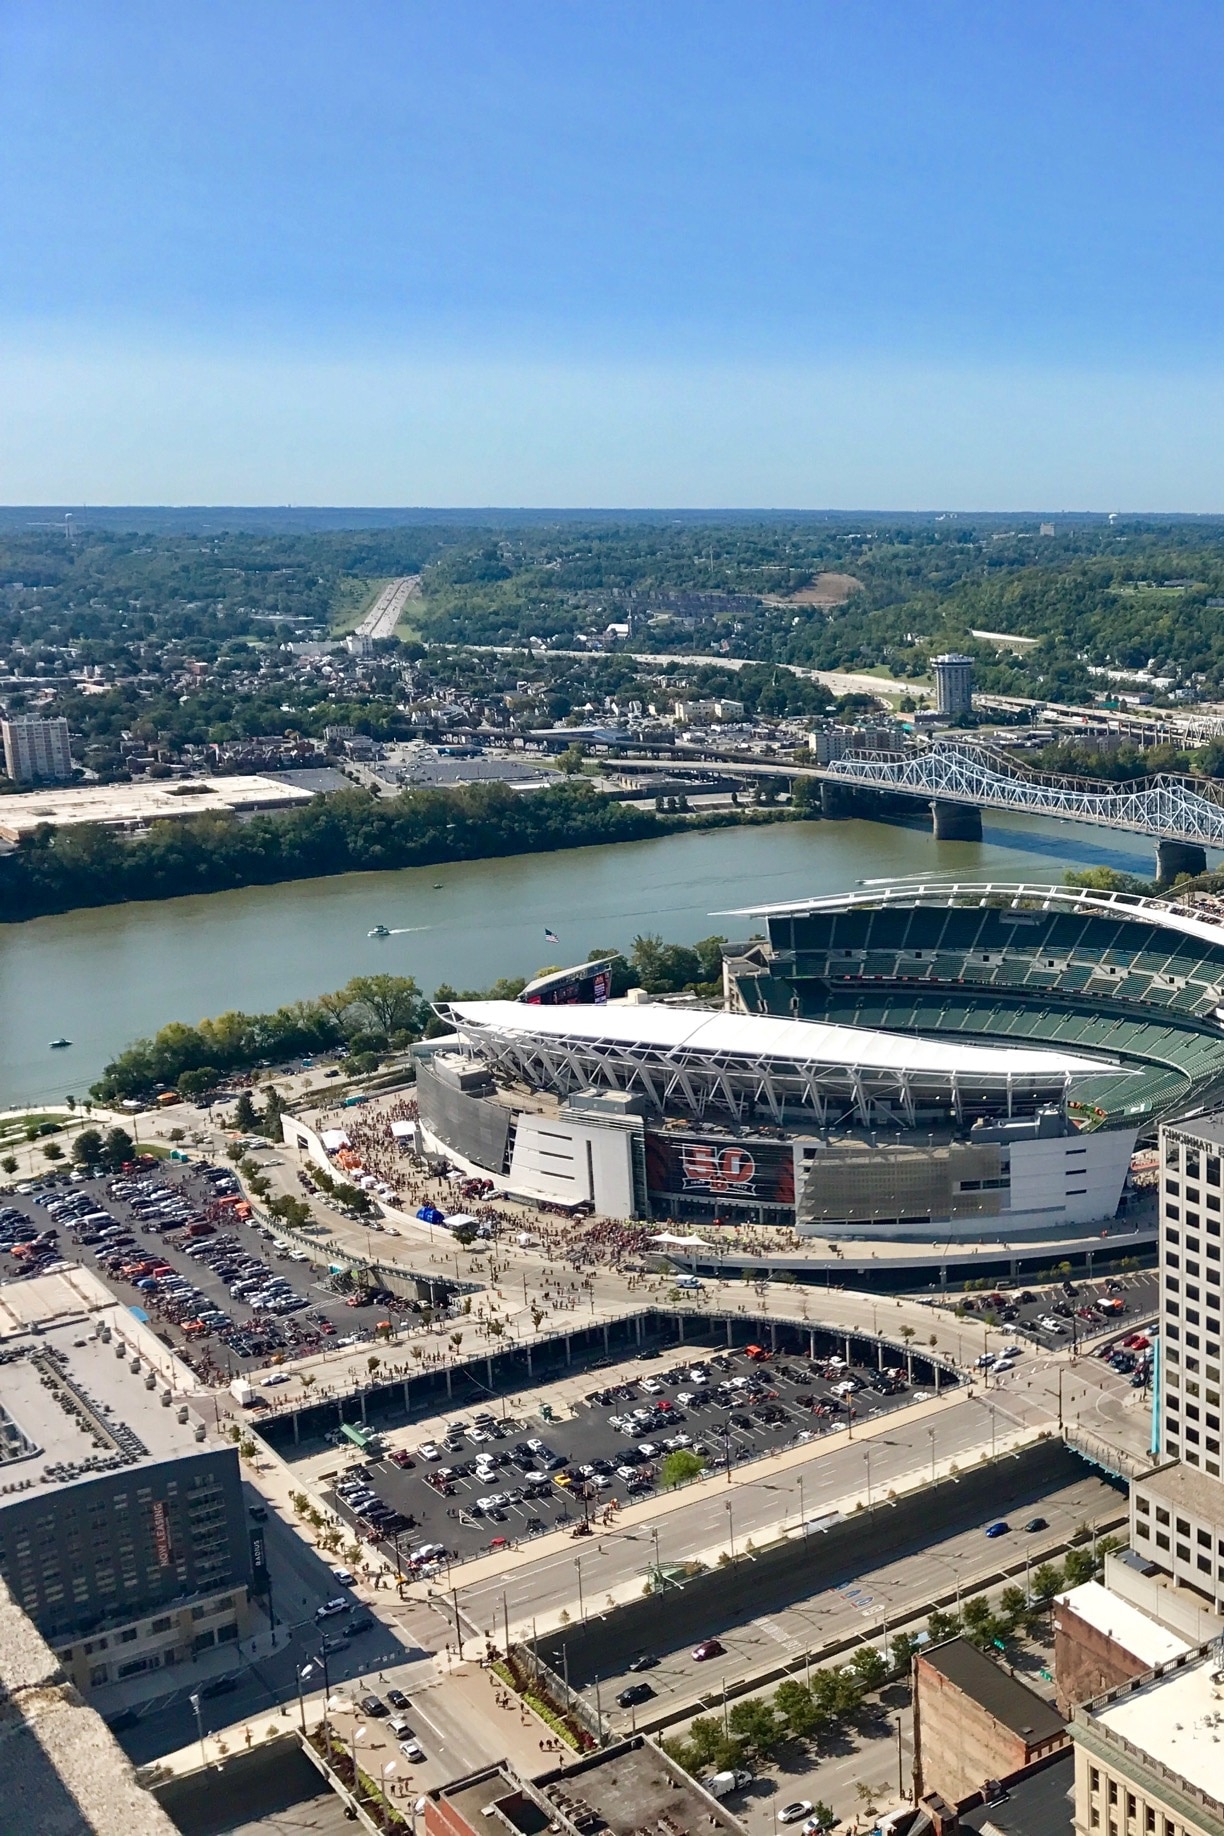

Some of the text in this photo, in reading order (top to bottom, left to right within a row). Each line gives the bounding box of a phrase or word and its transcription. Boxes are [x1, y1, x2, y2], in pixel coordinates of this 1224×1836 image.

[1162, 1128, 1213, 1153] CINCINNATI
[153, 1503, 169, 1567] NOW LEASING
[253, 1540, 261, 1566] RADIUS
